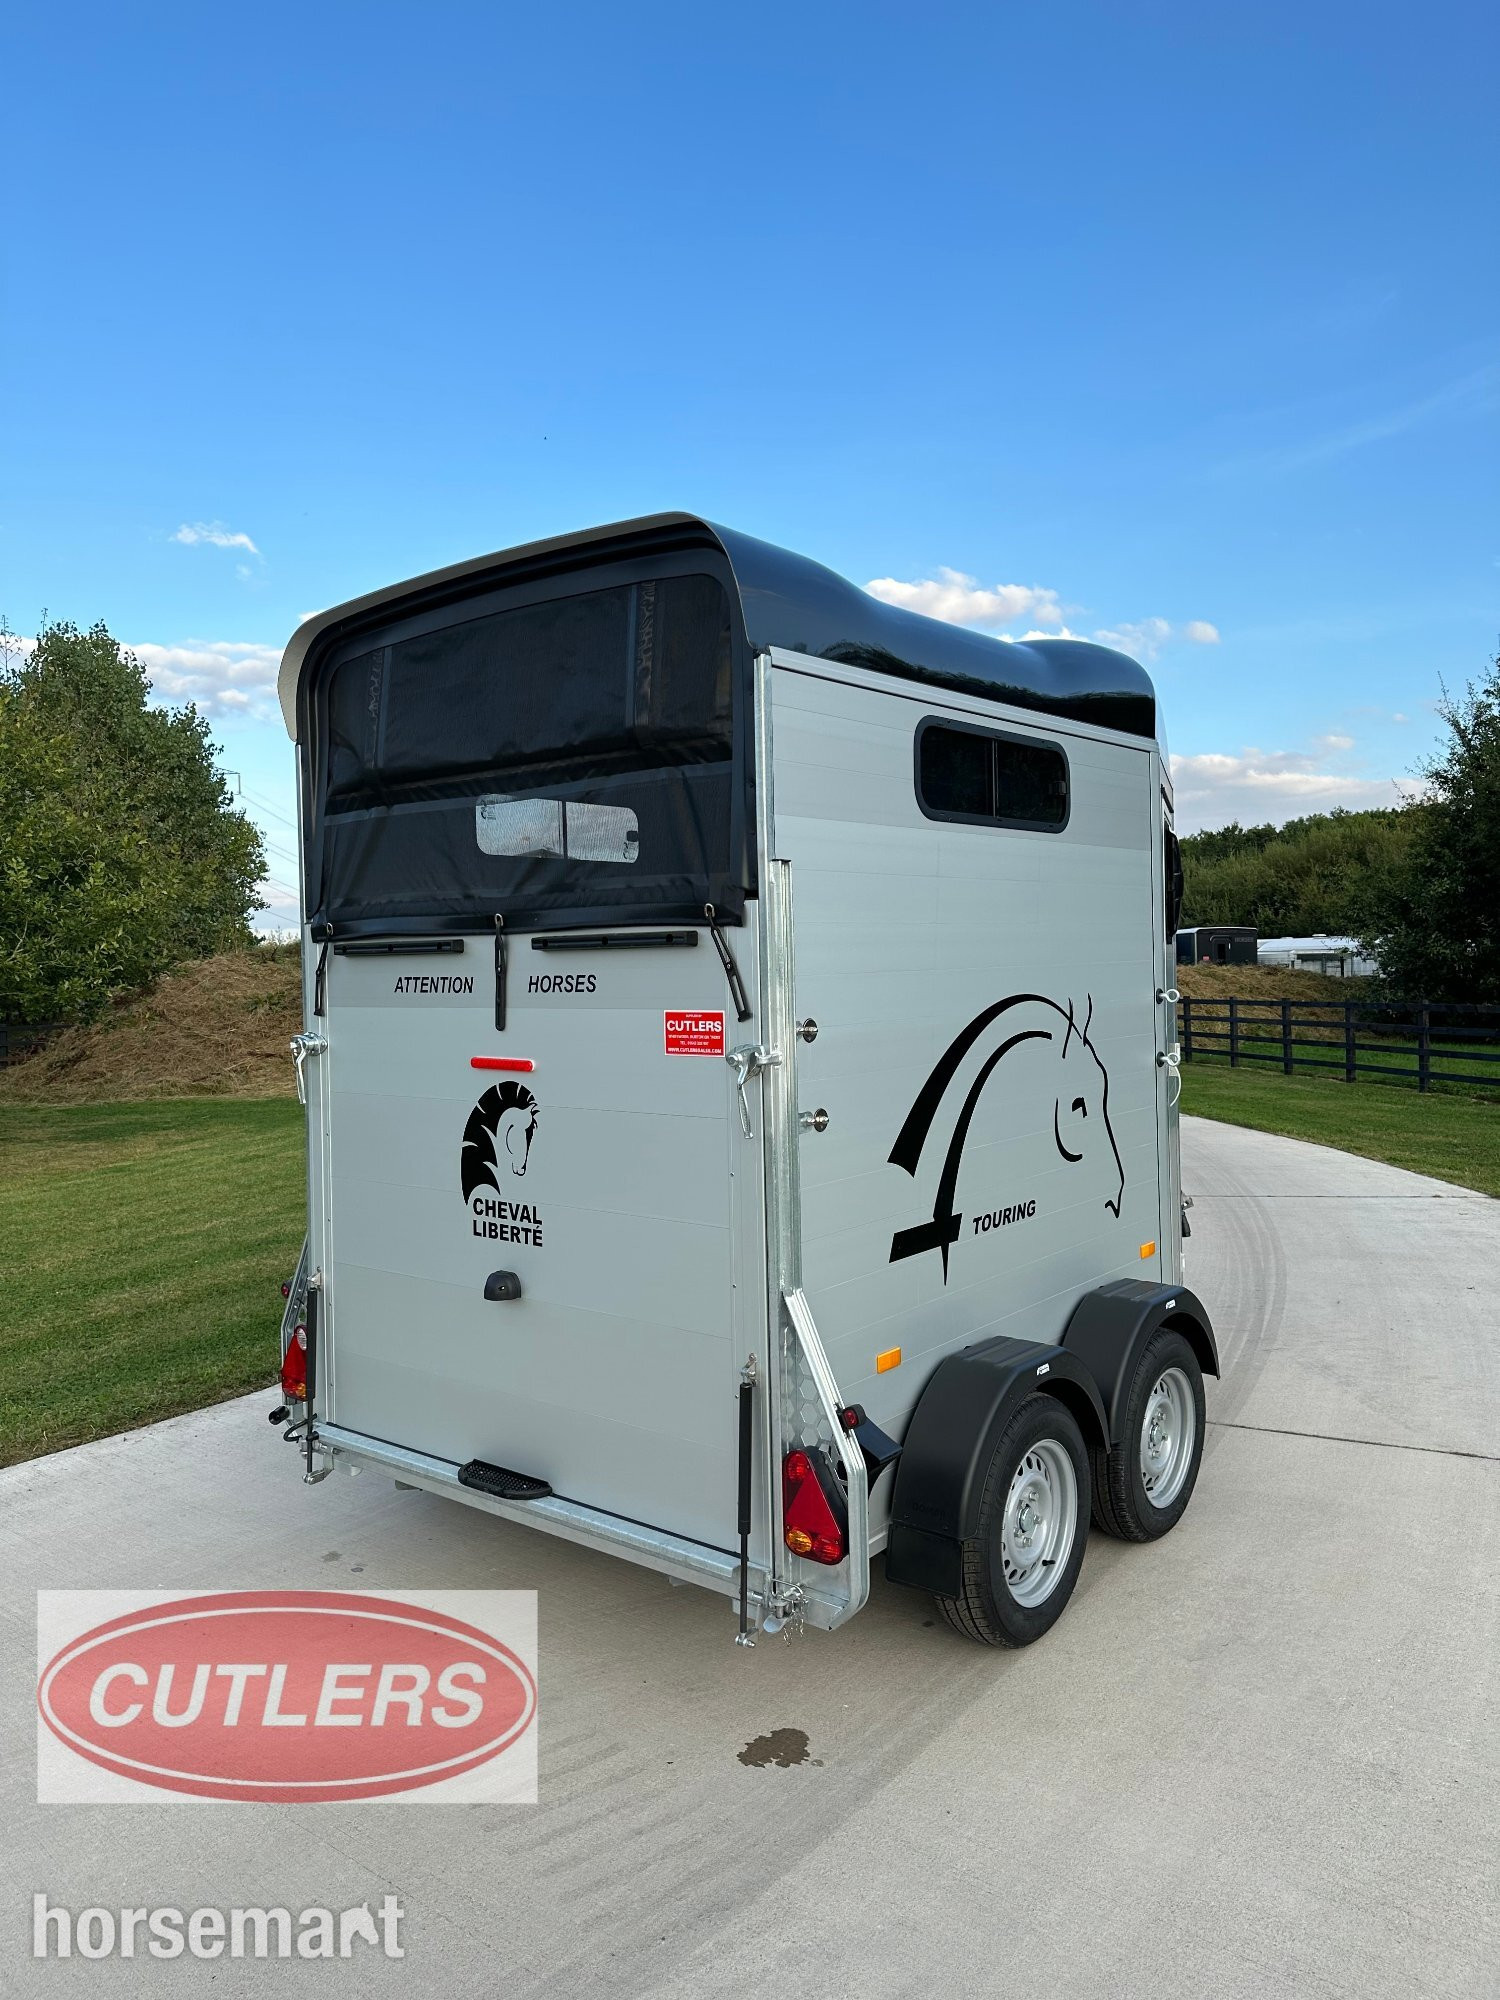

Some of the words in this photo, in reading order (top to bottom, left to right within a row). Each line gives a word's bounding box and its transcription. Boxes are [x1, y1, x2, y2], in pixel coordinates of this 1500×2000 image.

[394, 976, 474, 994] ATTENTION
[528, 974, 597, 993] HORSES
[666, 1020, 723, 1032] CUTLERS
[472, 1197, 543, 1226] CHEVAL
[972, 1199, 1036, 1235] TOURING
[472, 1219, 543, 1248] LIBERTÉ
